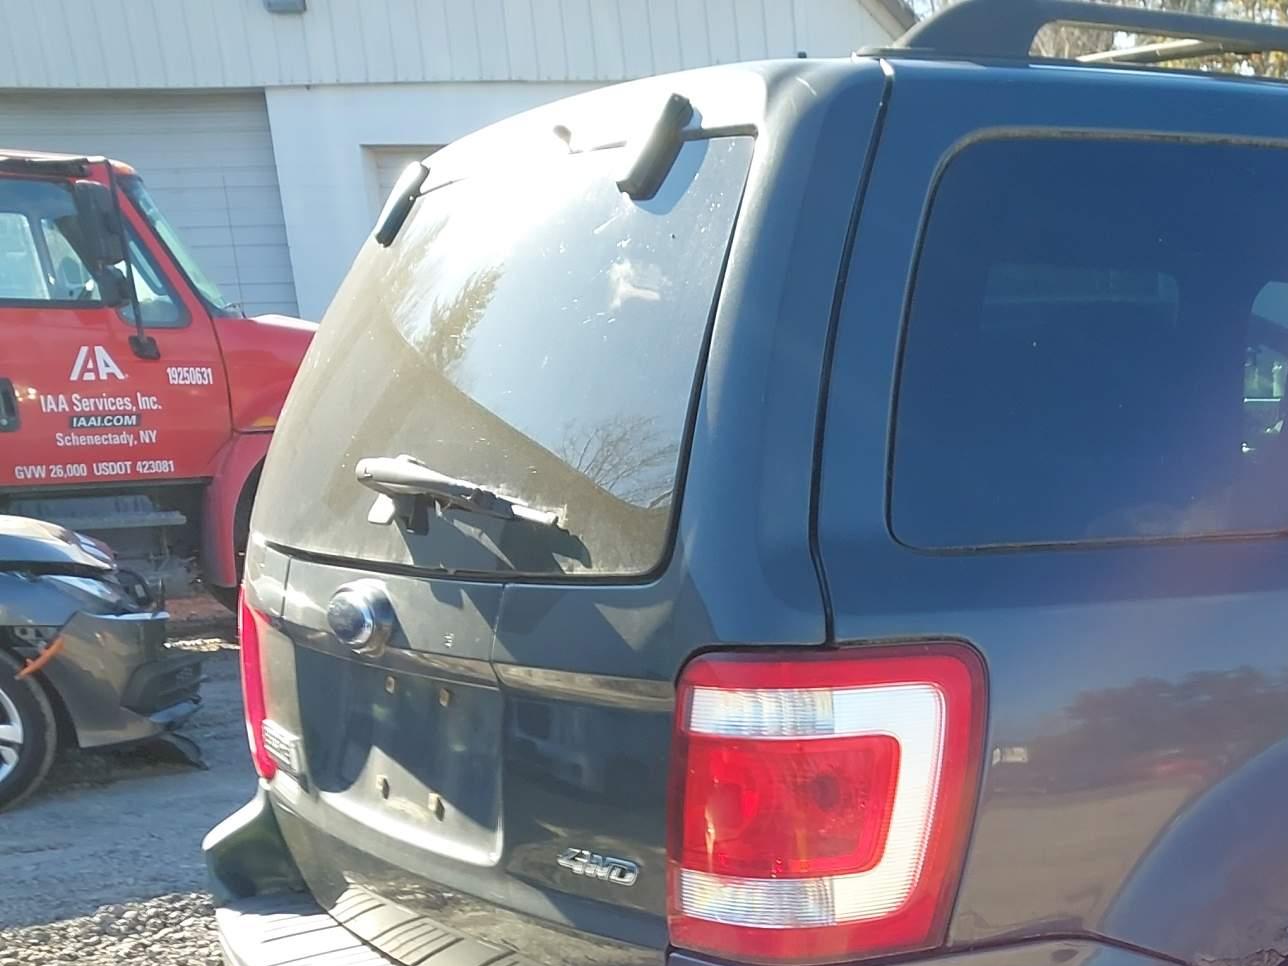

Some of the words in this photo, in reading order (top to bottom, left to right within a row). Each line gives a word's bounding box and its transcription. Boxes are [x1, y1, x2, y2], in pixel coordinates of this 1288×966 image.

[166, 367, 213, 385] 19250631
[40, 394, 69, 412] IAA
[72, 392, 136, 412] Services,
[137, 391, 162, 410] Inc.
[72, 415, 137, 427] IAAI.COM
[55, 430, 138, 447] Schenectady,
[139, 430, 157, 443] NY
[14, 465, 46, 480] GVW
[50, 463, 87, 478] 26,000
[94, 461, 132, 476] USDOT
[136, 460, 174, 473] 423081
[557, 847, 639, 886] 4WD
